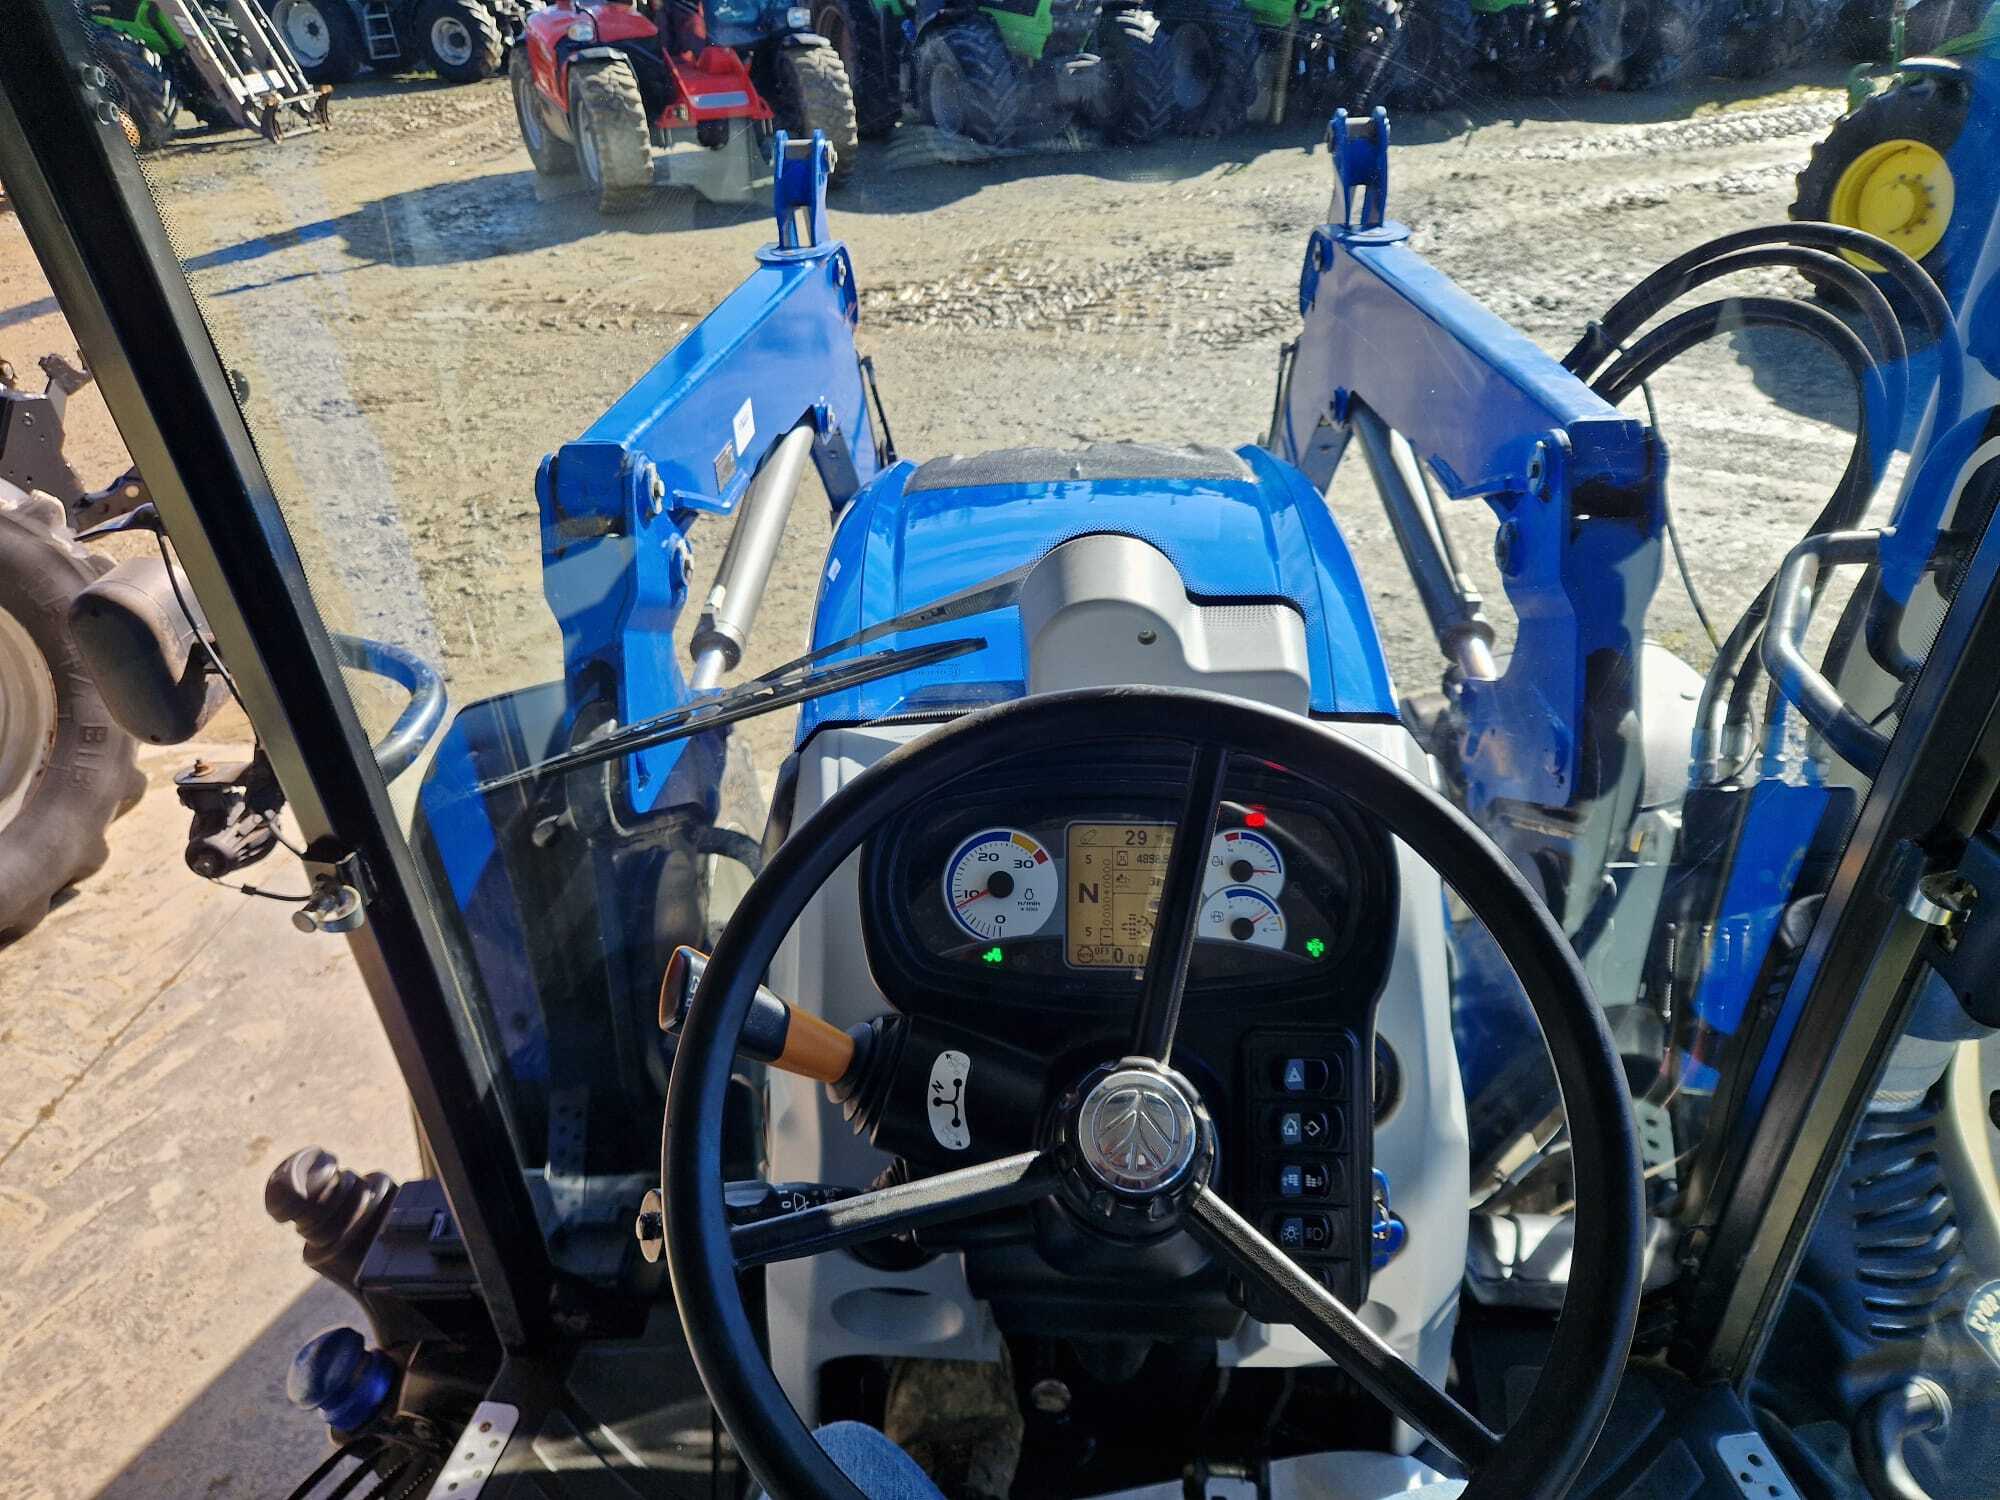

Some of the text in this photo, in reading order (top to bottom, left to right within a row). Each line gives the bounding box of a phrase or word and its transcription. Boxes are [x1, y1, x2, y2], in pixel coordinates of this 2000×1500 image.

[1125, 830, 1148, 846] 29
[977, 852, 1000, 862] 20
[1013, 859, 1035, 869] 30
[963, 889, 980, 899] 10
[1078, 882, 1099, 904] N
[994, 914, 1006, 924] 0
[931, 1080, 945, 1094] N
